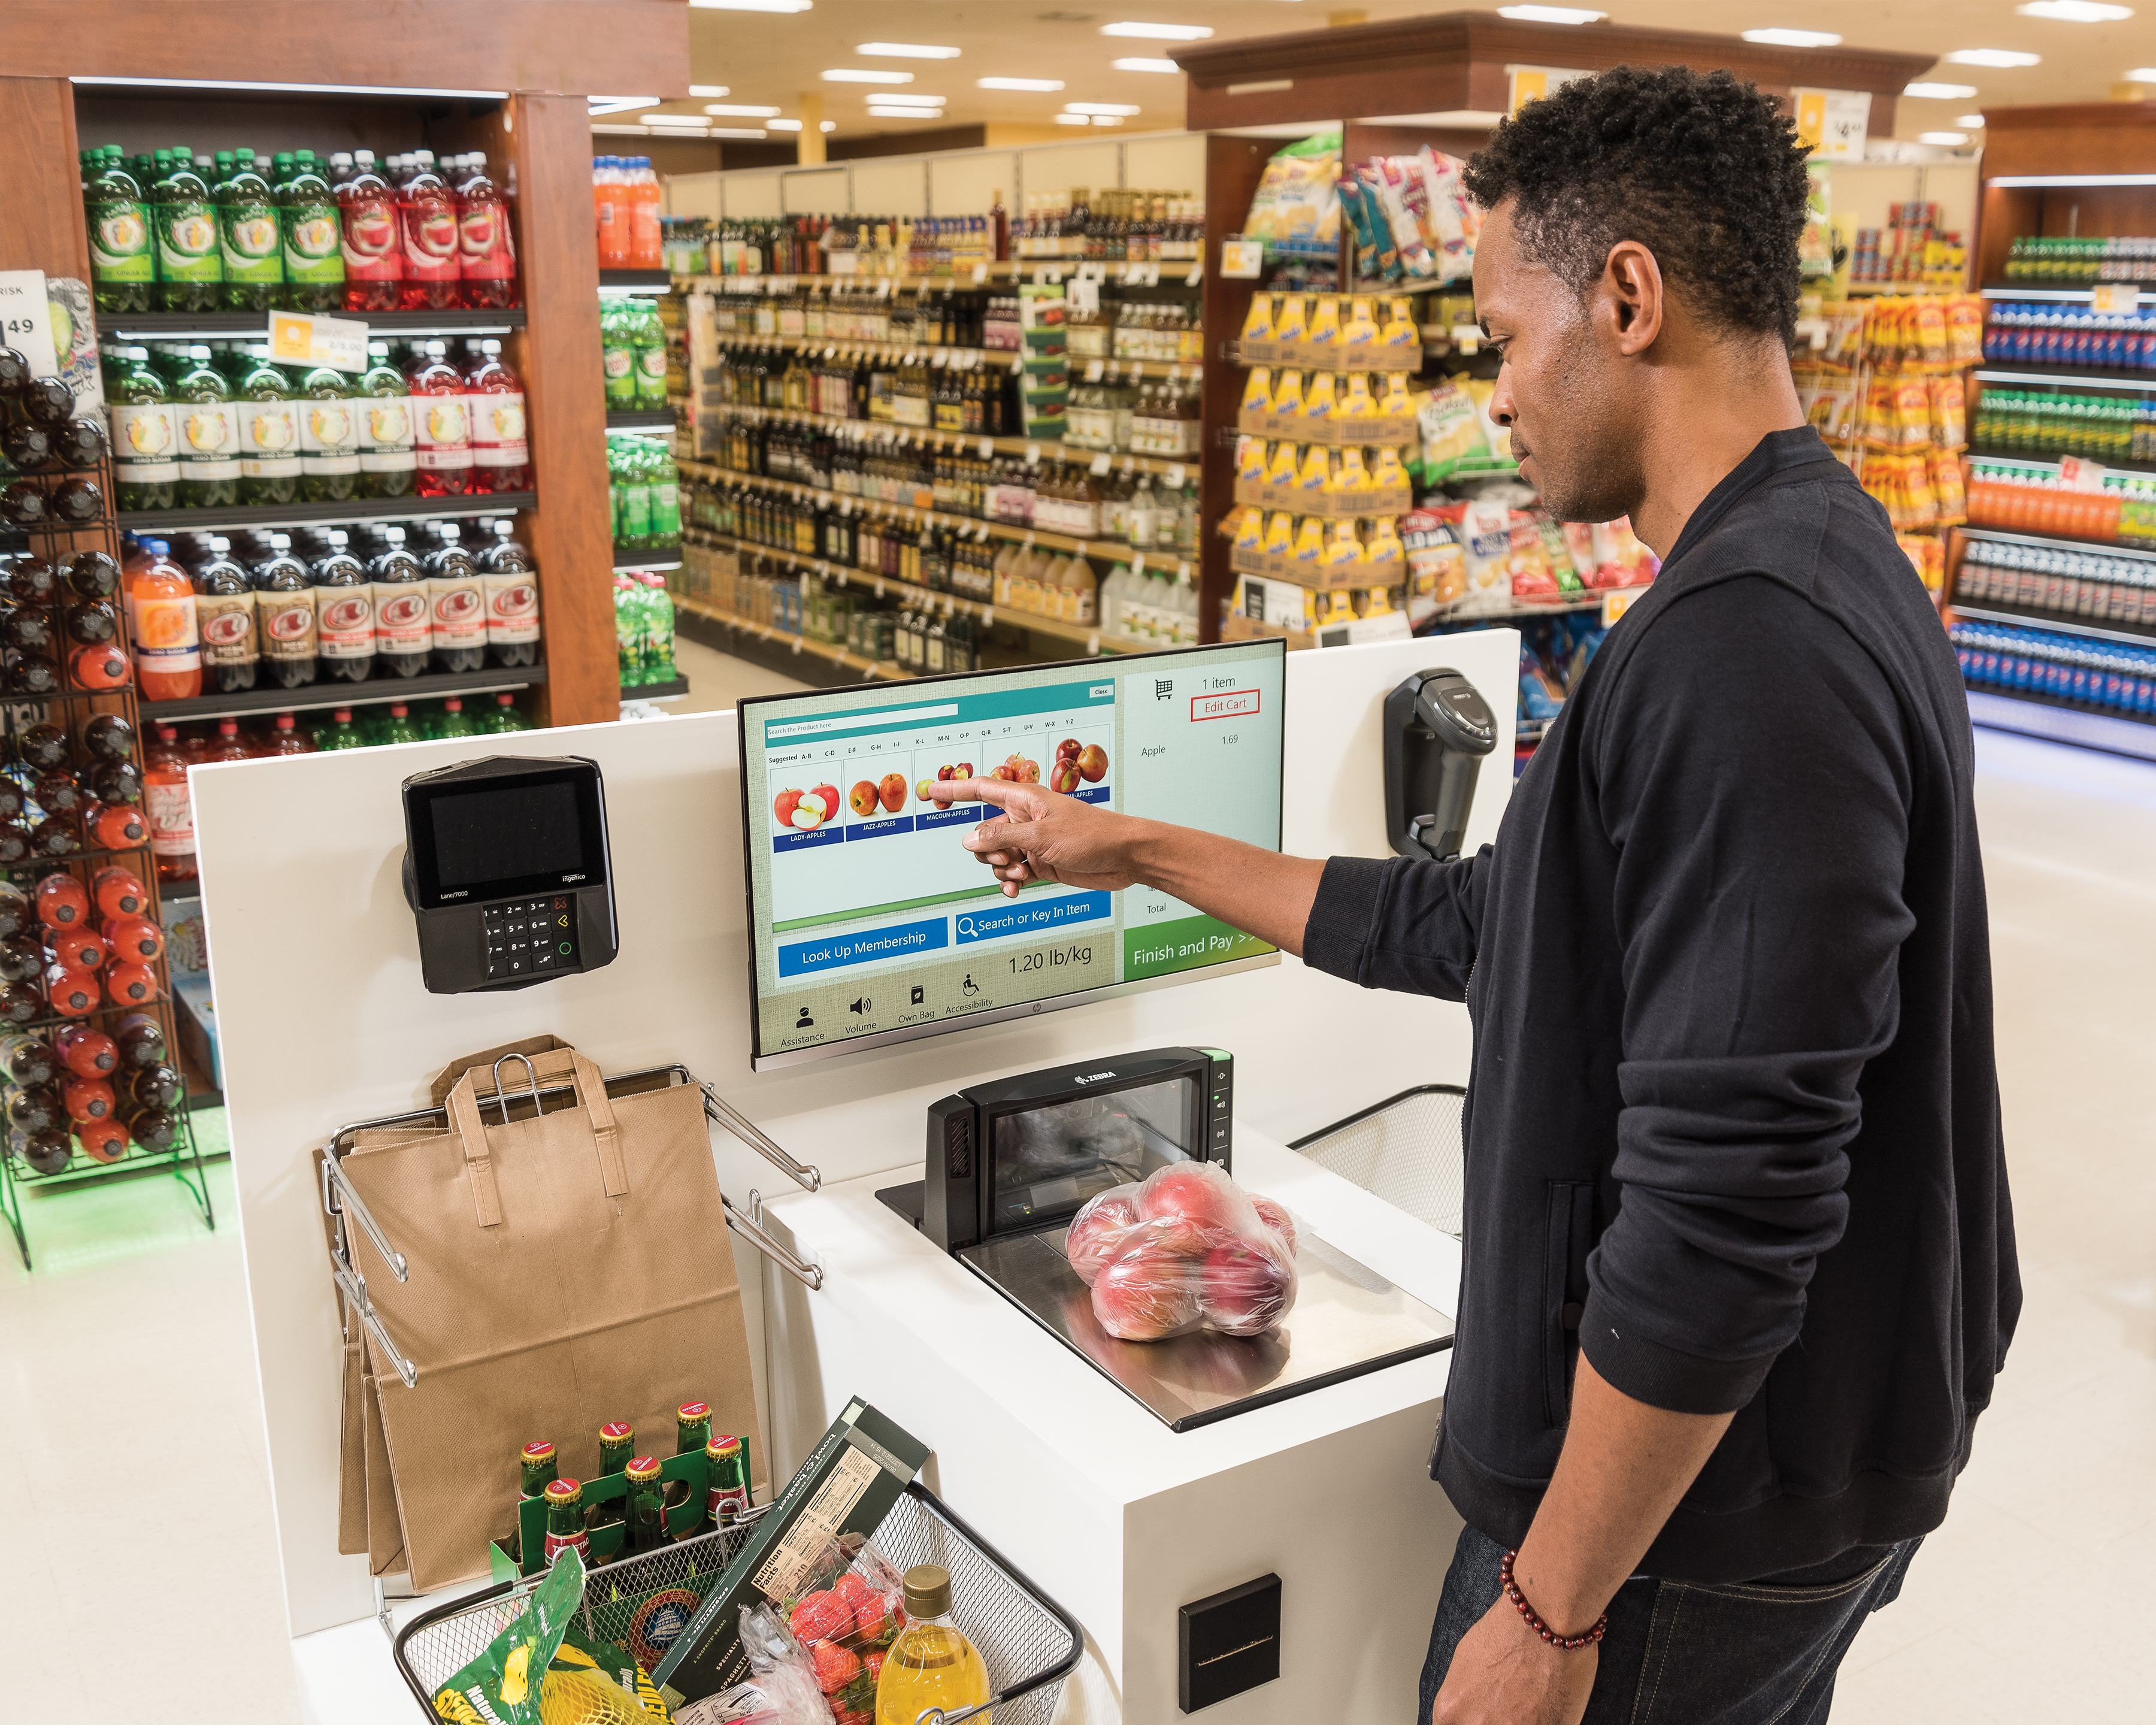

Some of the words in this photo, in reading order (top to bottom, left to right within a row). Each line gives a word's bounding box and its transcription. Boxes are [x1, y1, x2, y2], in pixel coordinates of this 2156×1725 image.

[1203, 679, 1207, 689] 1
[1212, 677, 1235, 688] item
[1205, 701, 1223, 713] Edit
[1227, 698, 1246, 710] Cart
[768, 727, 786, 736] Search
[797, 724, 817, 732] Product
[1141, 745, 1165, 757] Apple
[1222, 735, 1239, 744] 1.69
[769, 753, 798, 764] Suggested
[926, 809, 970, 821] MACOUN-APPLES
[863, 821, 896, 830] JAZZ-APPLES
[791, 831, 826, 842] LADY-APPLES
[562, 874, 586, 882] ingenico
[441, 891, 468, 900] Lane/7000
[1147, 903, 1166, 913] Total
[978, 915, 1014, 931] Search
[1018, 915, 1029, 924] or
[1032, 910, 1050, 923] Key
[1053, 908, 1064, 918] In
[1067, 902, 1090, 916] Item
[803, 947, 831, 964] Look
[834, 946, 851, 959] Up
[855, 931, 926, 954] Membership
[1134, 945, 1174, 965] Finish
[1179, 937, 1205, 955] and
[1210, 936, 1233, 951] Pay
[1009, 953, 1043, 974] 1.20
[1049, 946, 1091, 967] lb/kg
[946, 998, 993, 1014] Accessibility
[898, 1014, 917, 1023] Own
[920, 1010, 935, 1021] Bag
[845, 1021, 877, 1034] Volume
[780, 1032, 825, 1047] Assistance
[1088, 1071, 1116, 1081] ZEBRA
[682, 1402, 705, 1412] TSINGTAO
[610, 1423, 621, 1435] TSINGTAO
[528, 1442, 551, 1453] TSINGTAO
[714, 1436, 735, 1448] TSINGTAO
[813, 1432, 837, 1460] bowl
[637, 1457, 652, 1470] TSINGTAO
[804, 1460, 815, 1473] &
[871, 1453, 897, 1473] 08/09/2025
[556, 1479, 573, 1490] TSINGTAO
[553, 1538, 589, 1552] TSGTAO
[753, 1548, 783, 1585] Nutrition
[794, 1563, 807, 1579] 210
[758, 1565, 779, 1590] Facts
[700, 1586, 729, 1624] SPAGHETTI
[713, 1618, 727, 1635] BRAND
[715, 1638, 741, 1670] SPECIALTY
[720, 1654, 749, 1690] SPAGHETTI
[734, 1665, 748, 1682] MACARONI
